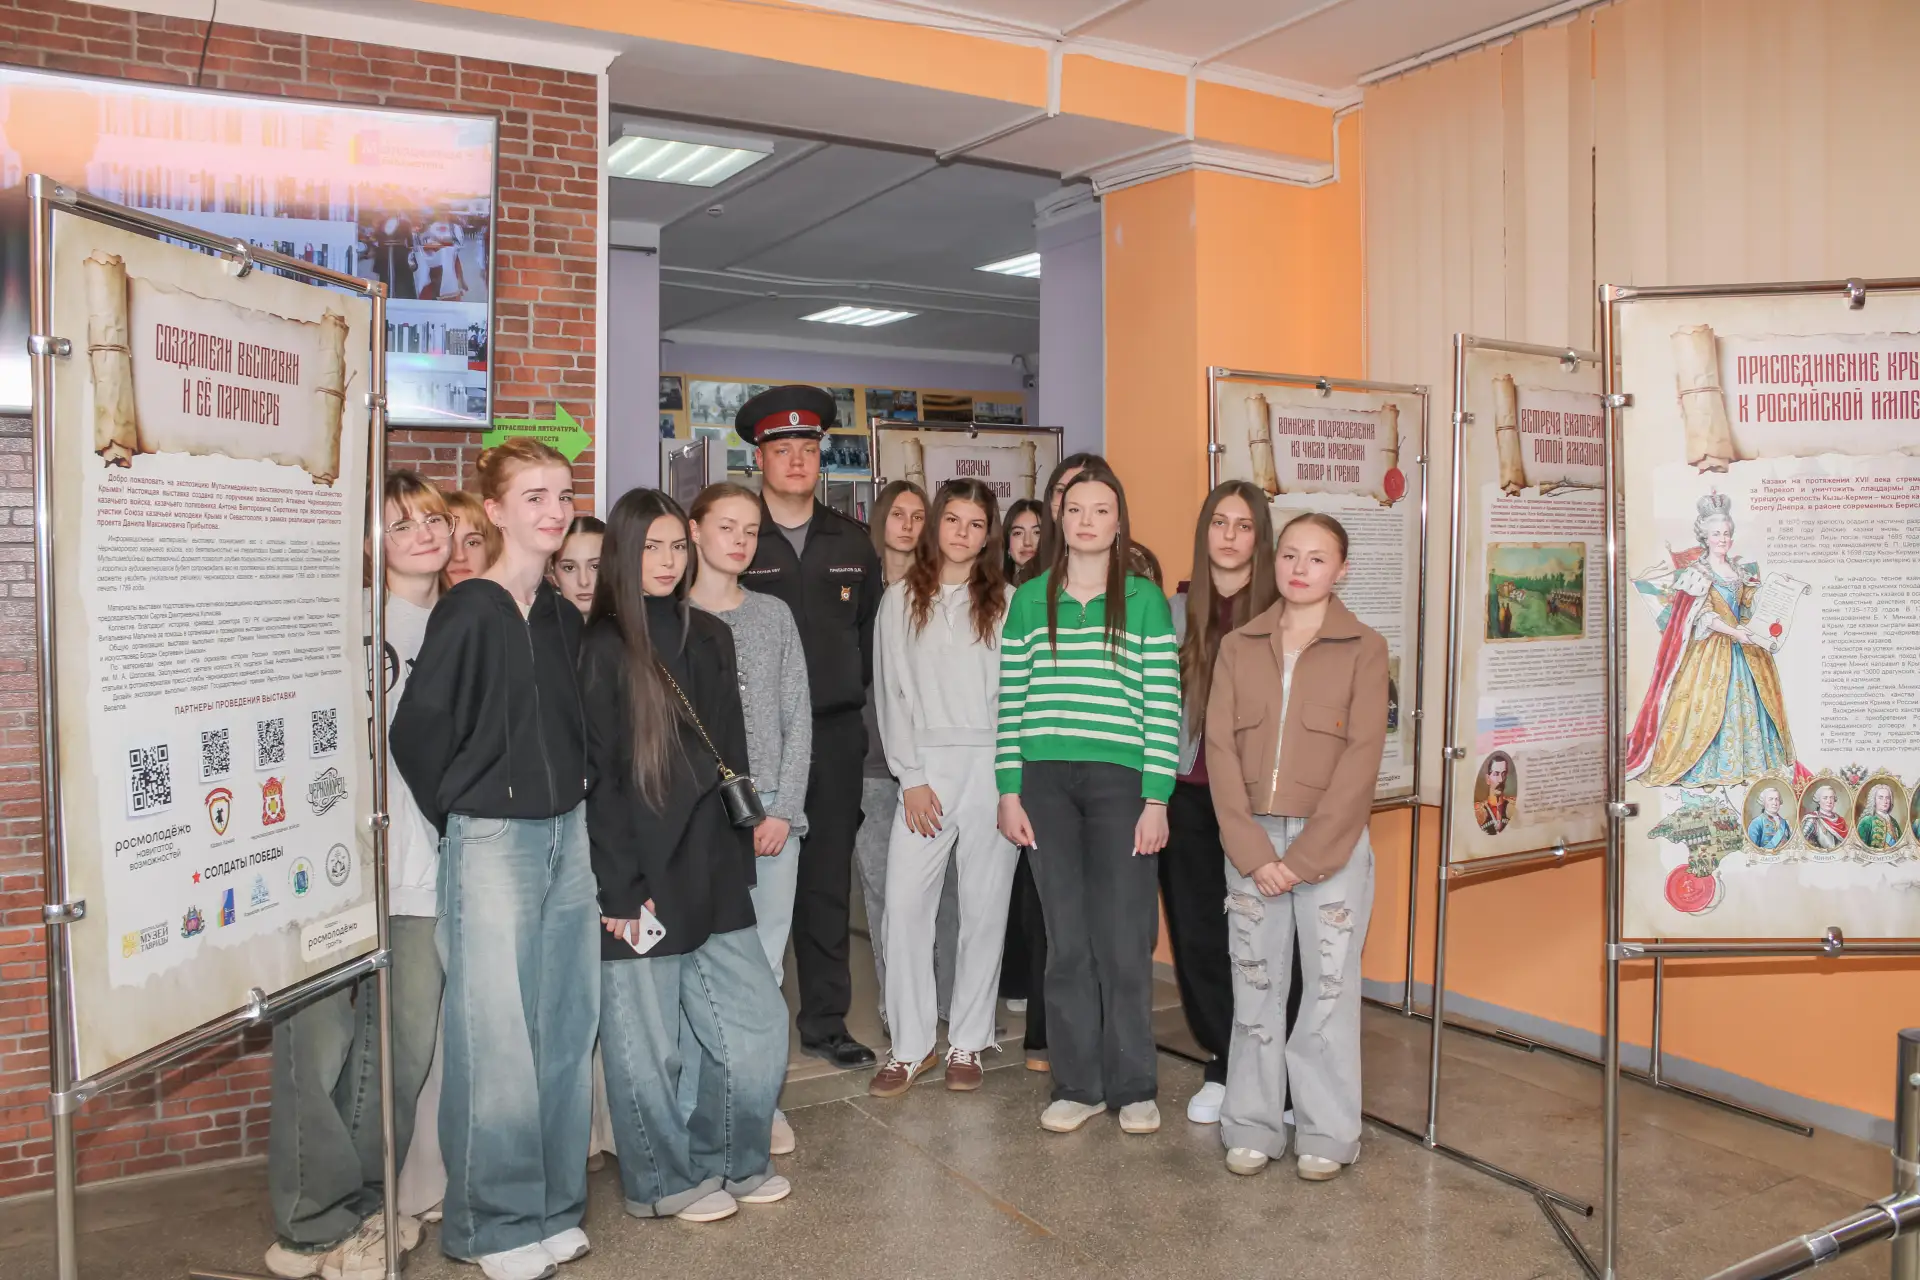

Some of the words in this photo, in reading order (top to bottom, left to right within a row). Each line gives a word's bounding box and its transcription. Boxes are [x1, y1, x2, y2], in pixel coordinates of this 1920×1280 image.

[156, 323, 232, 373] СОЗДАТЕЛИ
[238, 342, 300, 386] ВЫСТАВКИ
[1737, 352, 1879, 387] ПРИСОЕДИНЕНИЕ
[1887, 351, 1920, 381] КРЫ
[183, 378, 191, 414] И
[196, 377, 212, 417] ЕЁ
[217, 384, 280, 426] ПАРТНЕРЫ
[1739, 394, 1748, 422] К
[1757, 387, 1863, 422] РОССИЙСКОЙ
[1872, 389, 1920, 420] ИМПЕ
[1278, 417, 1316, 436] ВОИНСКИЕ
[1318, 420, 1375, 441] ПОДРАЗДЕЛЕНИЯ
[1521, 409, 1560, 435] ВСТРЕЧА
[1291, 440, 1300, 457] ИЗ
[1302, 441, 1325, 459] ЧИСЛА
[1328, 443, 1365, 461] КРЫМСКИХ
[1535, 437, 1563, 464] РОТОЙ
[1566, 441, 1604, 467] АМАЗОНО
[956, 460, 990, 476] КАЗАЧЬИ
[1297, 463, 1324, 480] ТАТАР
[1326, 465, 1332, 481] И
[1334, 465, 1360, 483] ГРЕКОВ
[108, 474, 128, 483] Добро
[130, 477, 165, 486] пожаловать
[176, 480, 209, 489] экспозицию
[127, 487, 159, 496] Настоящая
[1860, 485, 1903, 493] плацдармы
[97, 497, 127, 505] казачьего
[1750, 496, 1786, 504] турецкую
[1822, 494, 1873, 502] Кызы-Кермен
[1750, 504, 1775, 512] берегу
[97, 509, 121, 517] участии
[124, 508, 143, 517] Союза
[204, 512, 222, 520] Крыма
[97, 519, 121, 528] проекта
[123, 519, 145, 528] Данила
[147, 520, 185, 528] Максимовича
[175, 702, 213, 715] ПАРТНЕРЫ
[215, 695, 260, 709] ПРОВЕДЕНИЯ
[261, 691, 297, 703] ВЫСТАВКИ
[115, 824, 191, 857] росмолодёжь
[136, 842, 174, 858] навигатор
[129, 849, 181, 871] возможностей
[204, 857, 248, 879] СОЛДАТЫ
[249, 846, 284, 866] ПОБЕДЫ
[140, 937, 168, 952] ТАВРИДЫ
[308, 923, 358, 951] росмолодёжь
